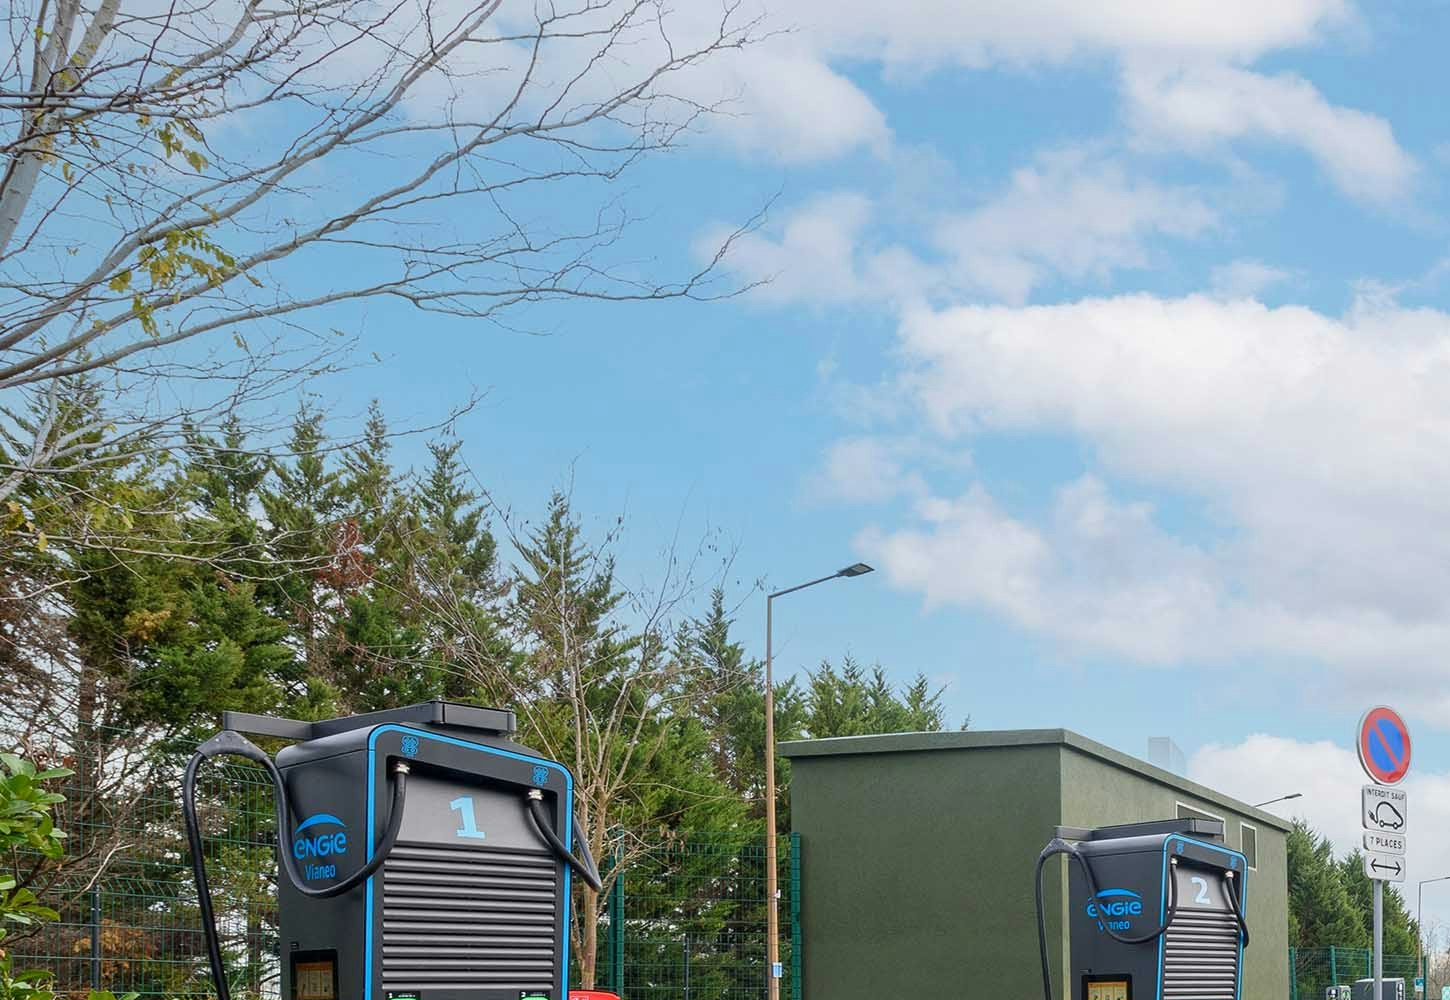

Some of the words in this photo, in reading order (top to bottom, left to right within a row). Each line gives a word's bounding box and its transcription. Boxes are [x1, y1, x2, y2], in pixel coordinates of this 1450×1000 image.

[450, 797, 486, 839] 1
[1375, 837, 1402, 849] PLACES
[305, 864, 336, 880] Vianeo
[1191, 877, 1210, 904] 2
